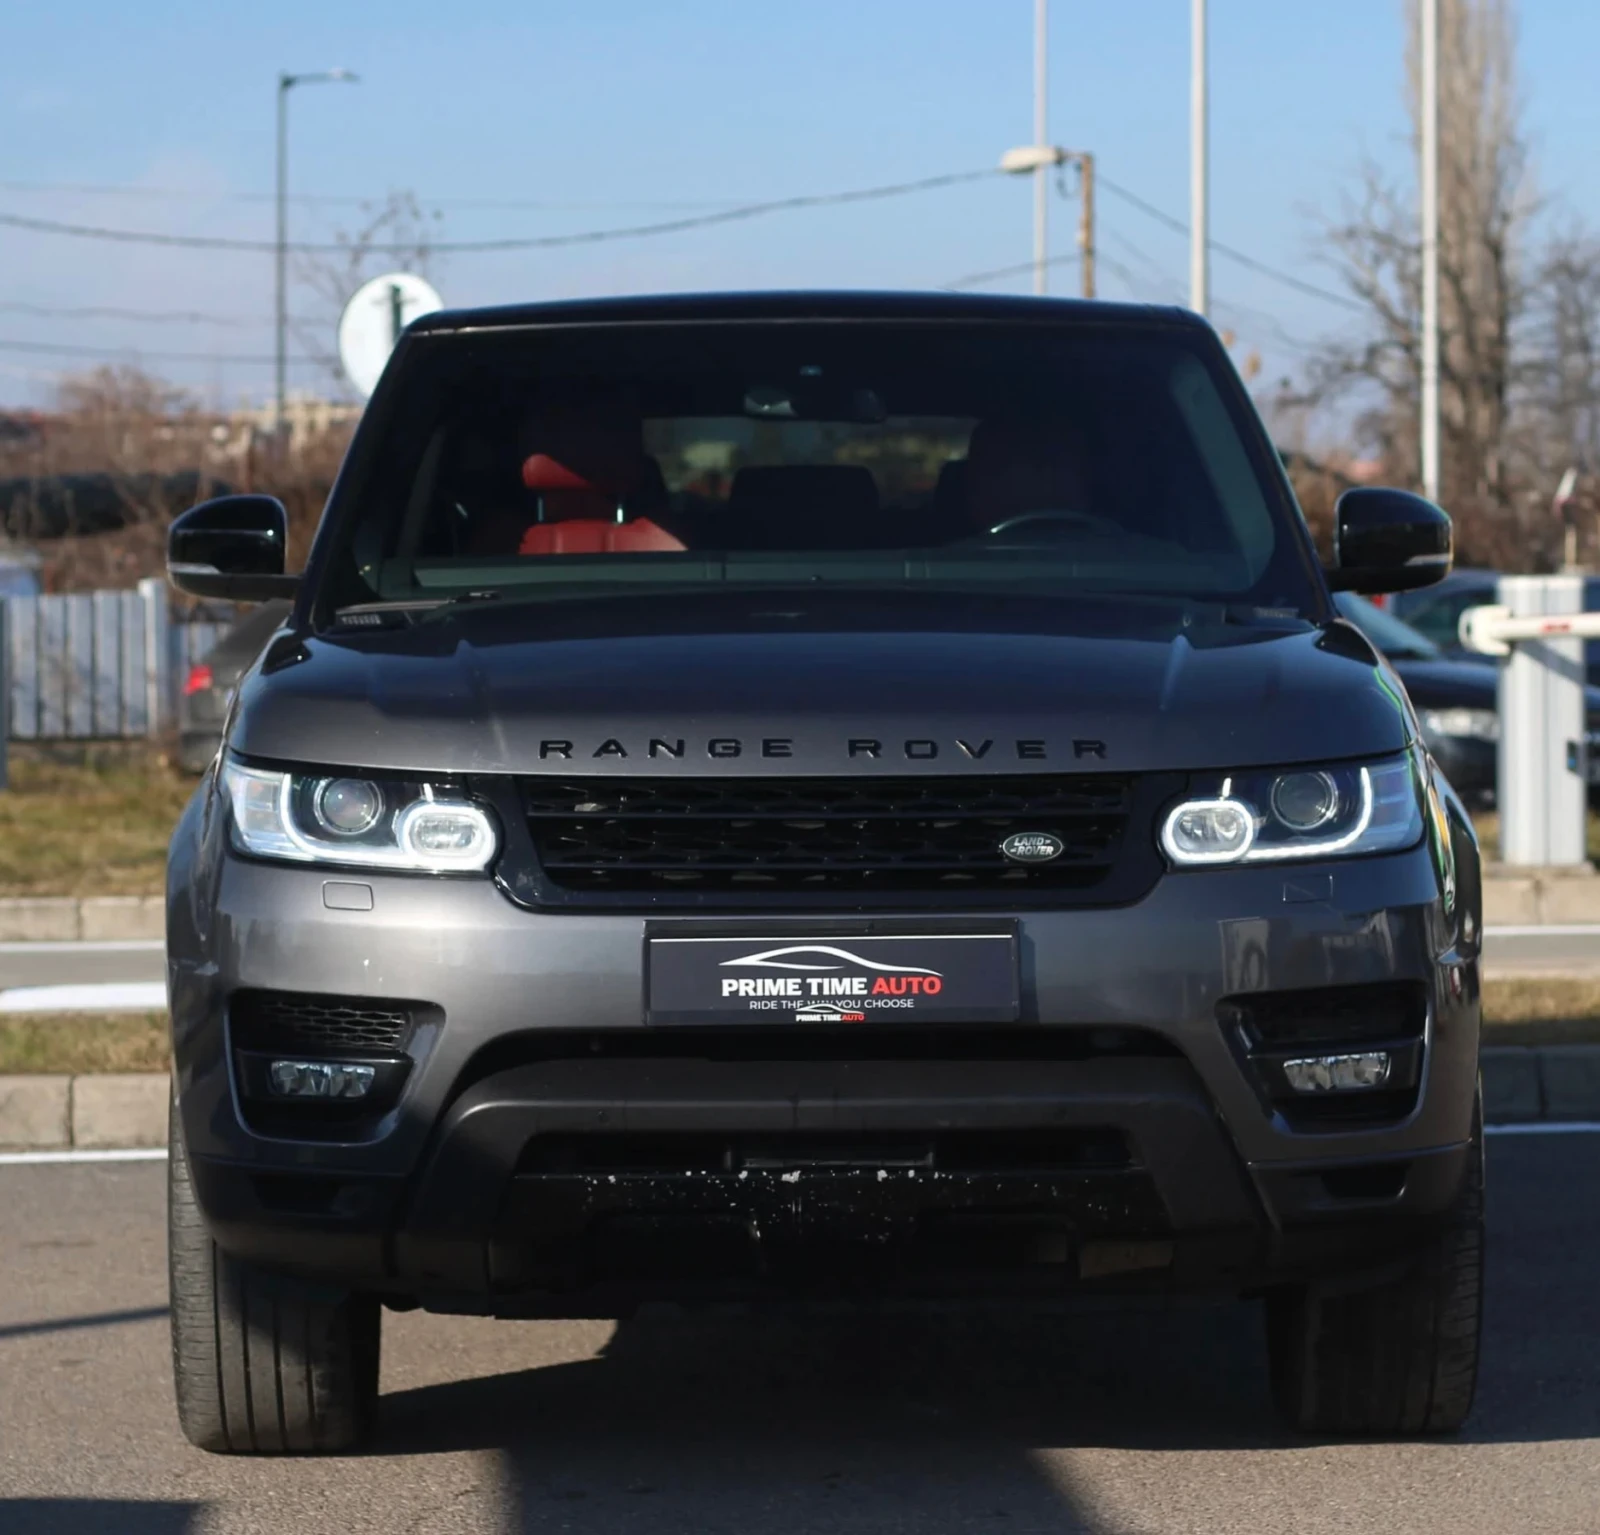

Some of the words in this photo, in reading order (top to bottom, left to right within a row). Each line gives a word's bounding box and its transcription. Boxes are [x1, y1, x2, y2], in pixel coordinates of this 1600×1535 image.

[538, 738, 793, 759] RANGE
[848, 738, 1107, 760] ROVER
[1013, 837, 1045, 847] LAND
[1016, 845, 1054, 856] ROVER
[721, 978, 802, 997] PRIME
[806, 977, 868, 996] TIME
[872, 976, 943, 995] AUTO
[749, 1000, 778, 1010] RIDE
[835, 999, 862, 1009] YOU
[864, 998, 915, 1009] CHOOSE
